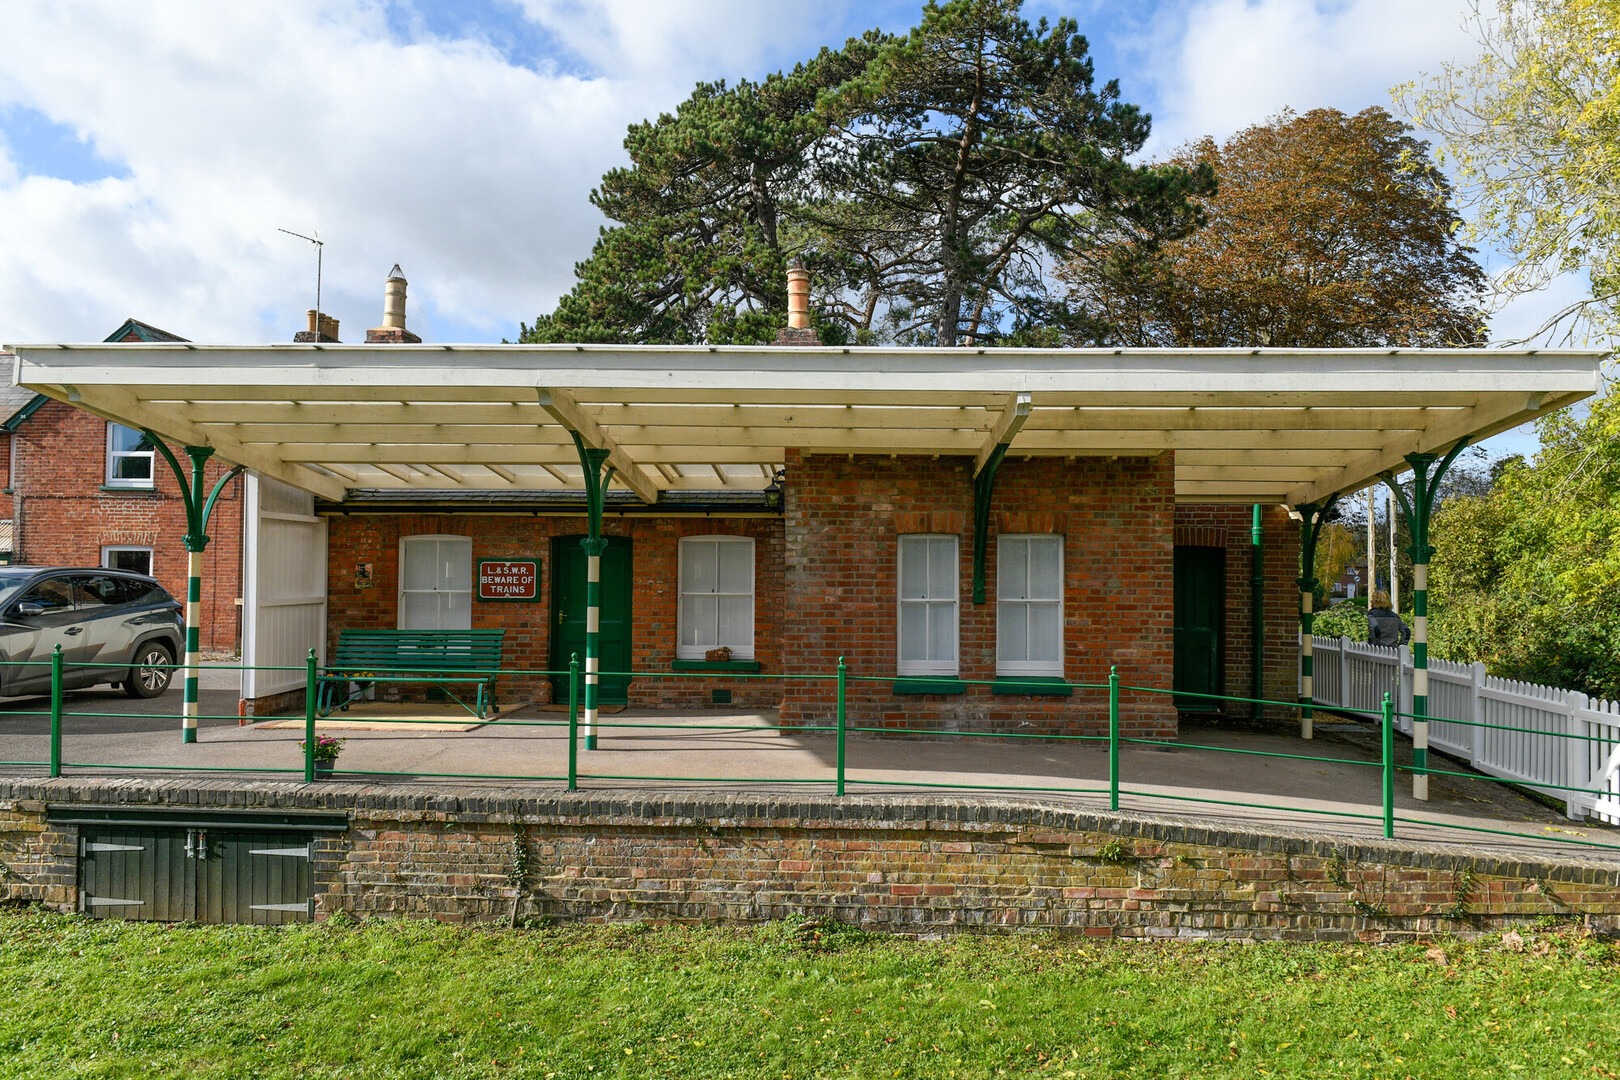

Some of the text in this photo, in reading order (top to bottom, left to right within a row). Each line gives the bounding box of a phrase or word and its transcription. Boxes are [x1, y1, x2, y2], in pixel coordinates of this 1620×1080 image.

[481, 576, 534, 584] BEWARE OF
[490, 585, 526, 593] TRAINS
